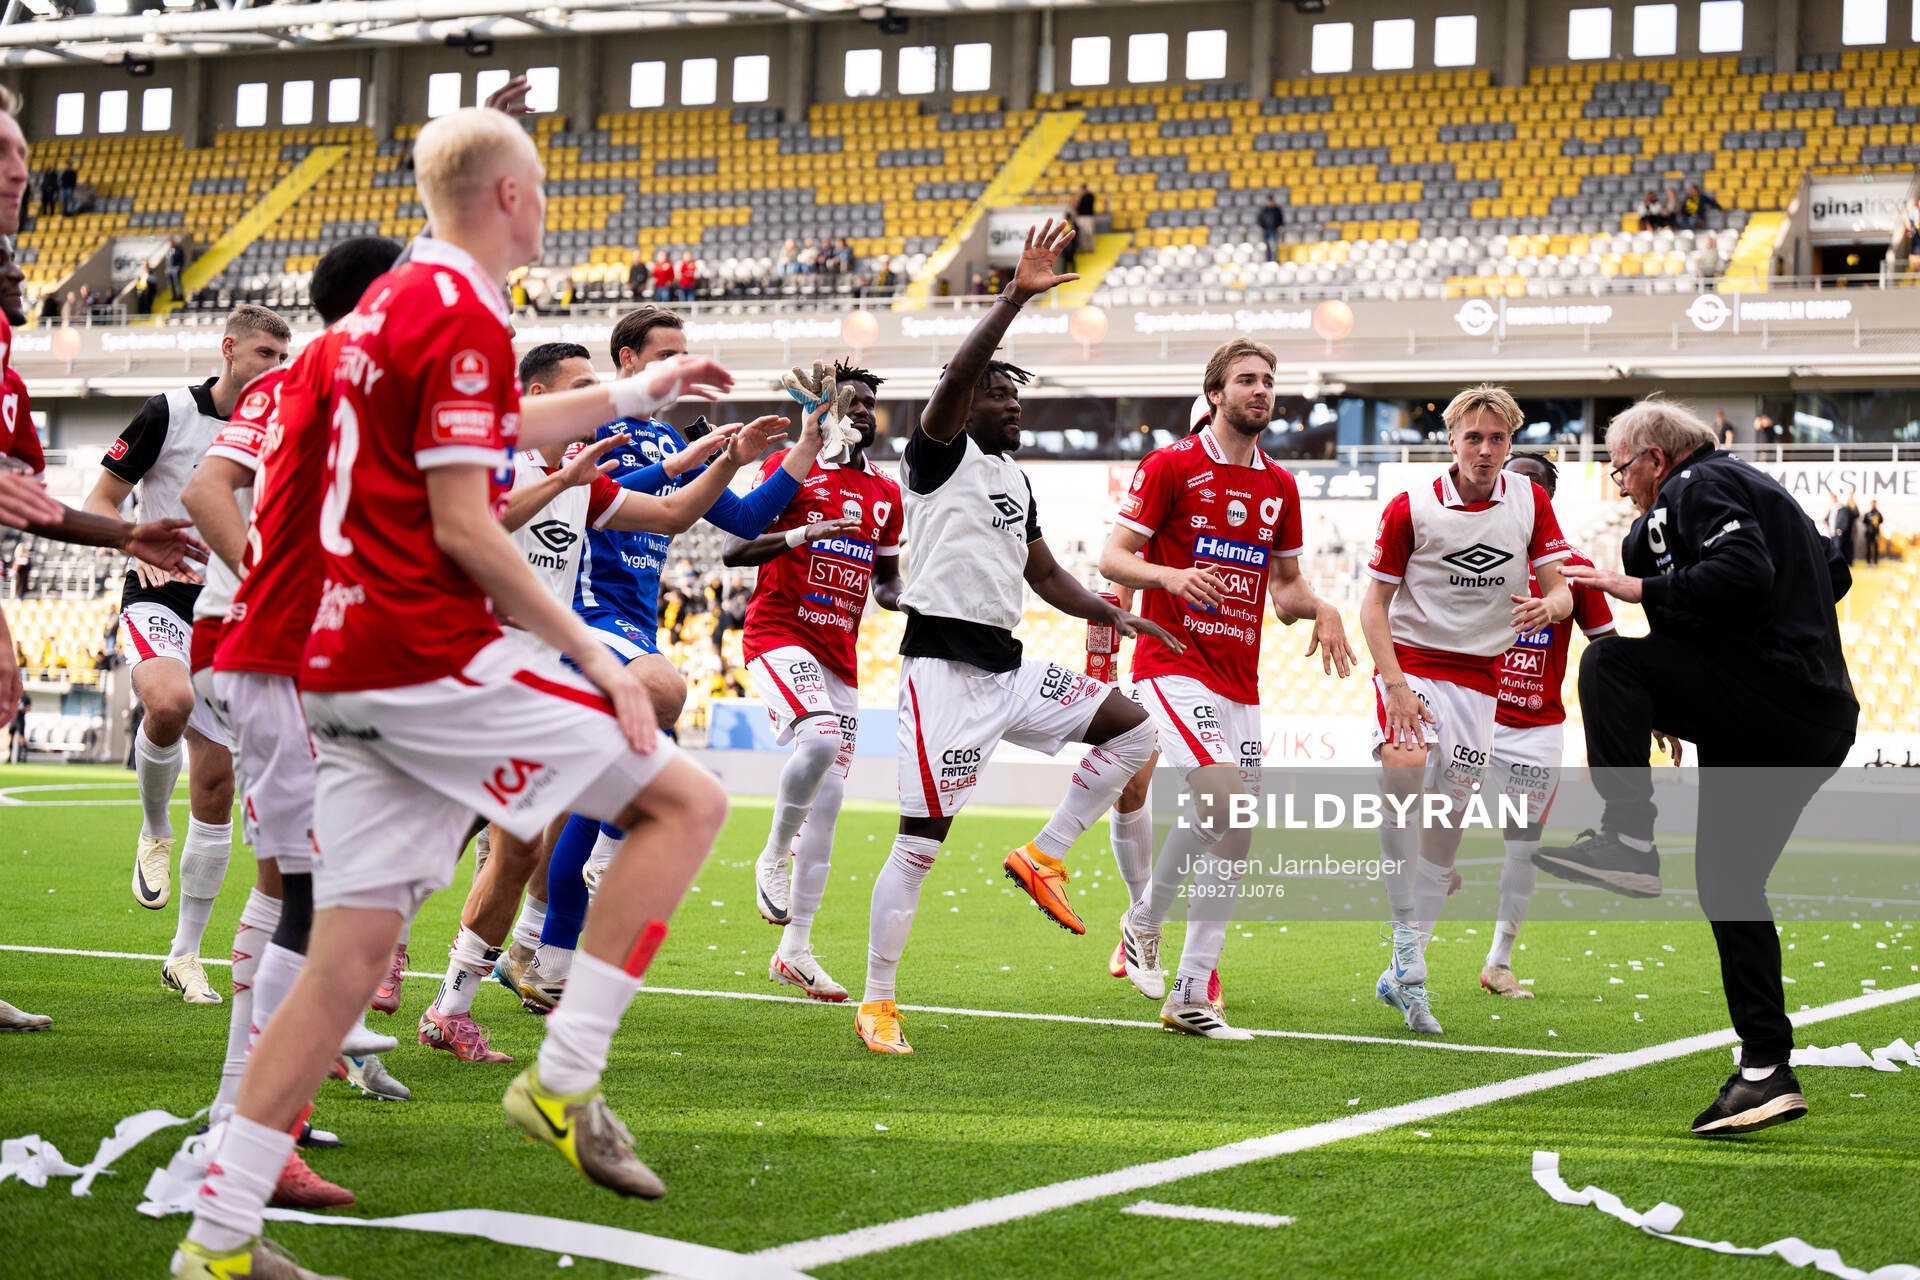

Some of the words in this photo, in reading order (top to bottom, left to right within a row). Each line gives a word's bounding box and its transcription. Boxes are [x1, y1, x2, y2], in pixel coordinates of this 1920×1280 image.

[1225, 488, 1252, 499] Helmia
[1196, 537, 1265, 564] Helmia
[1450, 574, 1506, 587] umbro
[1500, 676, 1544, 692] Munkfors
[807, 694, 818, 705] 15
[942, 748, 981, 765] CEOS
[1453, 744, 1487, 766] CEOS
[1510, 763, 1550, 780] CEOS
[481, 757, 545, 807] ICA
[940, 774, 977, 790] D-LAB
[1508, 776, 1548, 790] FRITZOE
